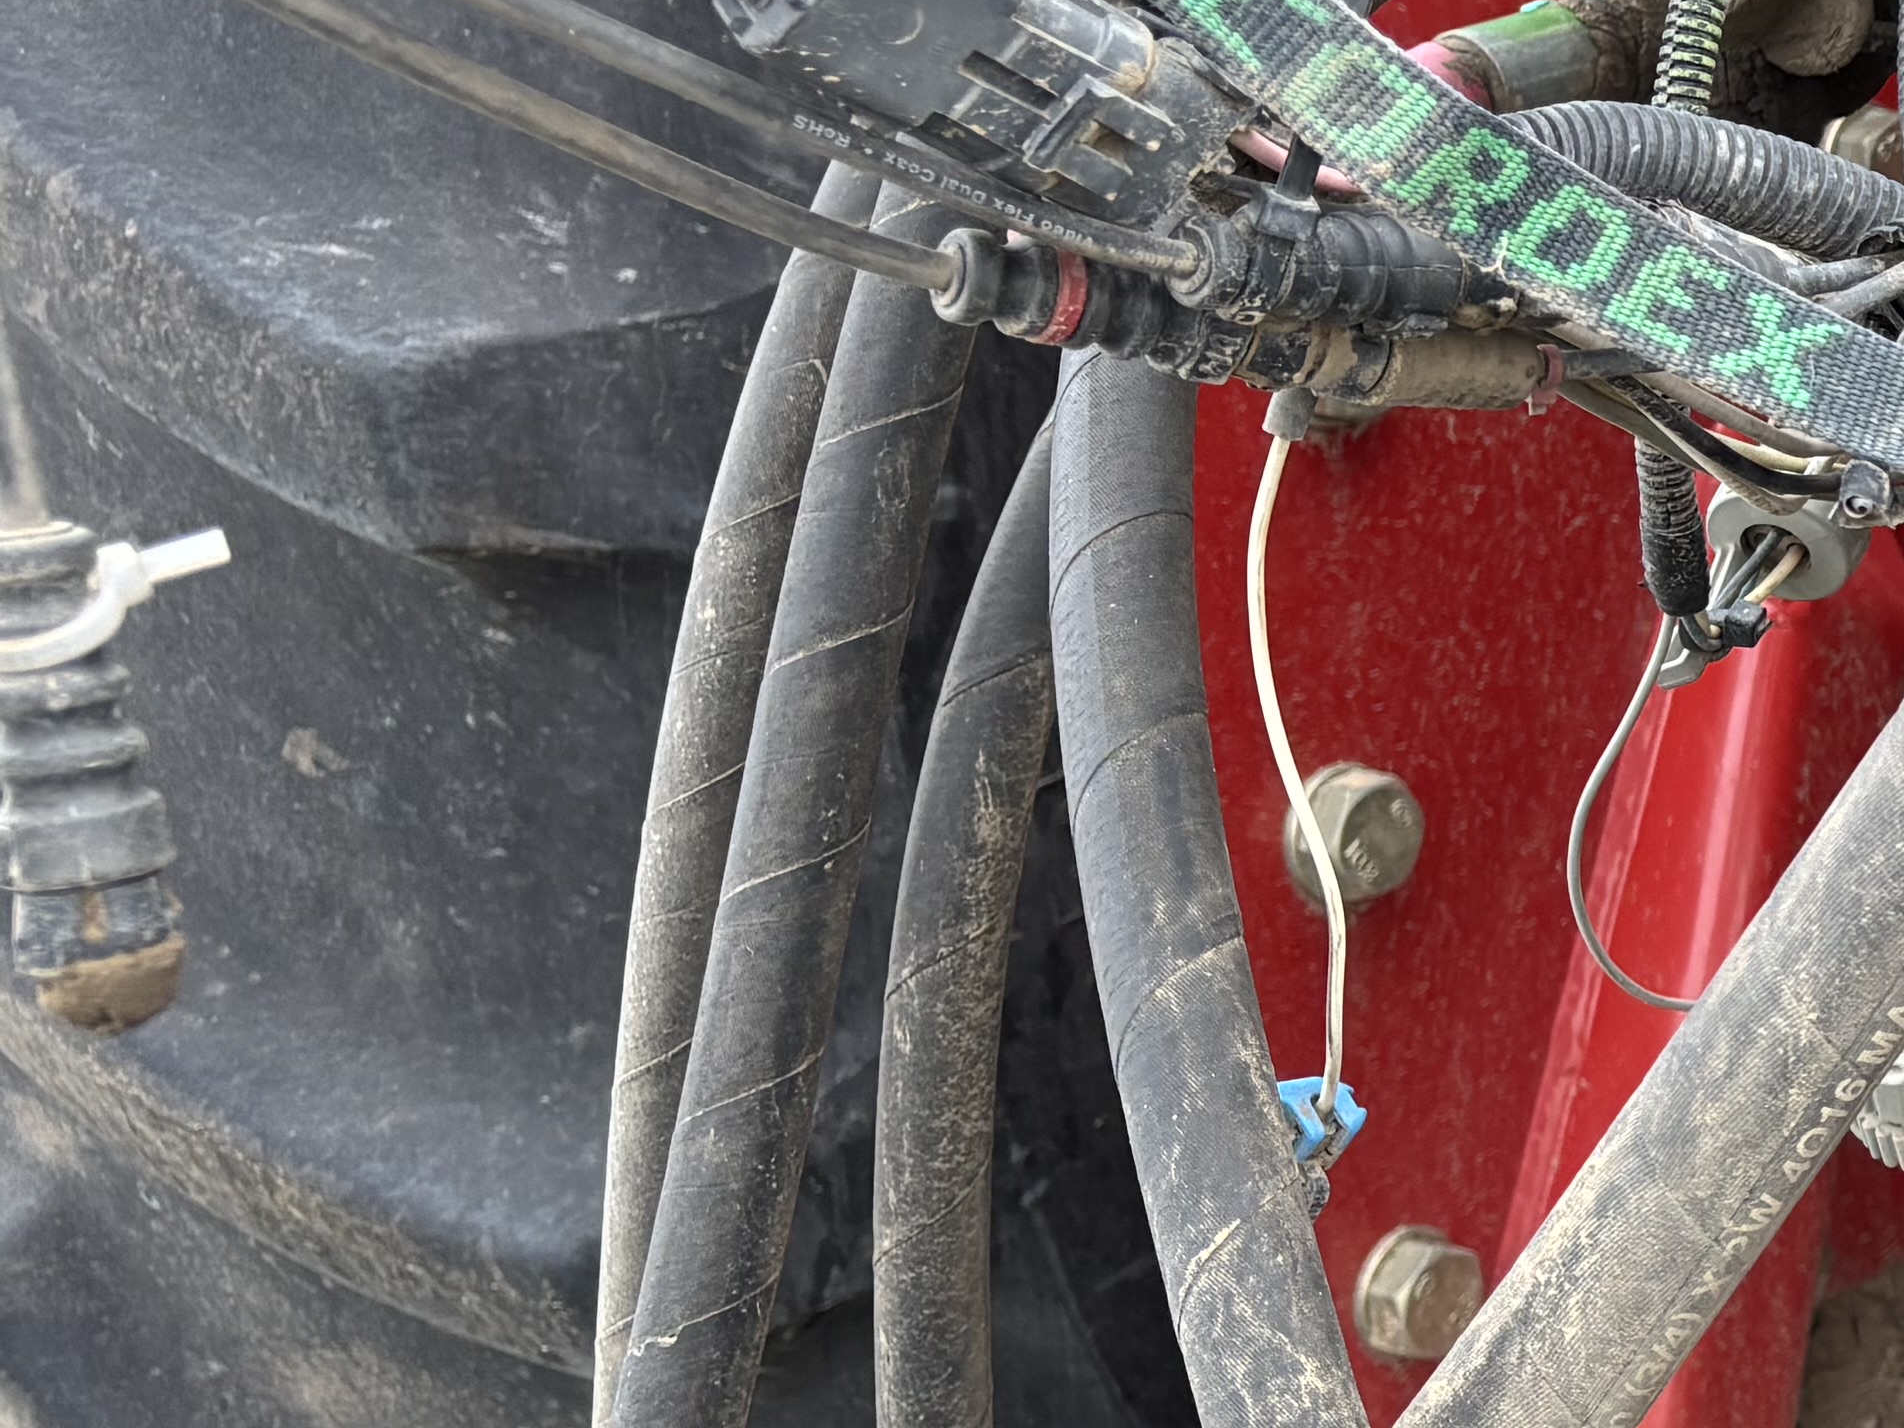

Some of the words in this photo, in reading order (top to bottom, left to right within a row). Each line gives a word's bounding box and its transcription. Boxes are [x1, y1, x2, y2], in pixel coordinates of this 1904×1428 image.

[791, 113, 851, 149] RoHS
[882, 153, 936, 183] Coax
[939, 176, 988, 205] Dual
[992, 198, 1035, 226] Flex
[1041, 219, 1094, 247] Video
